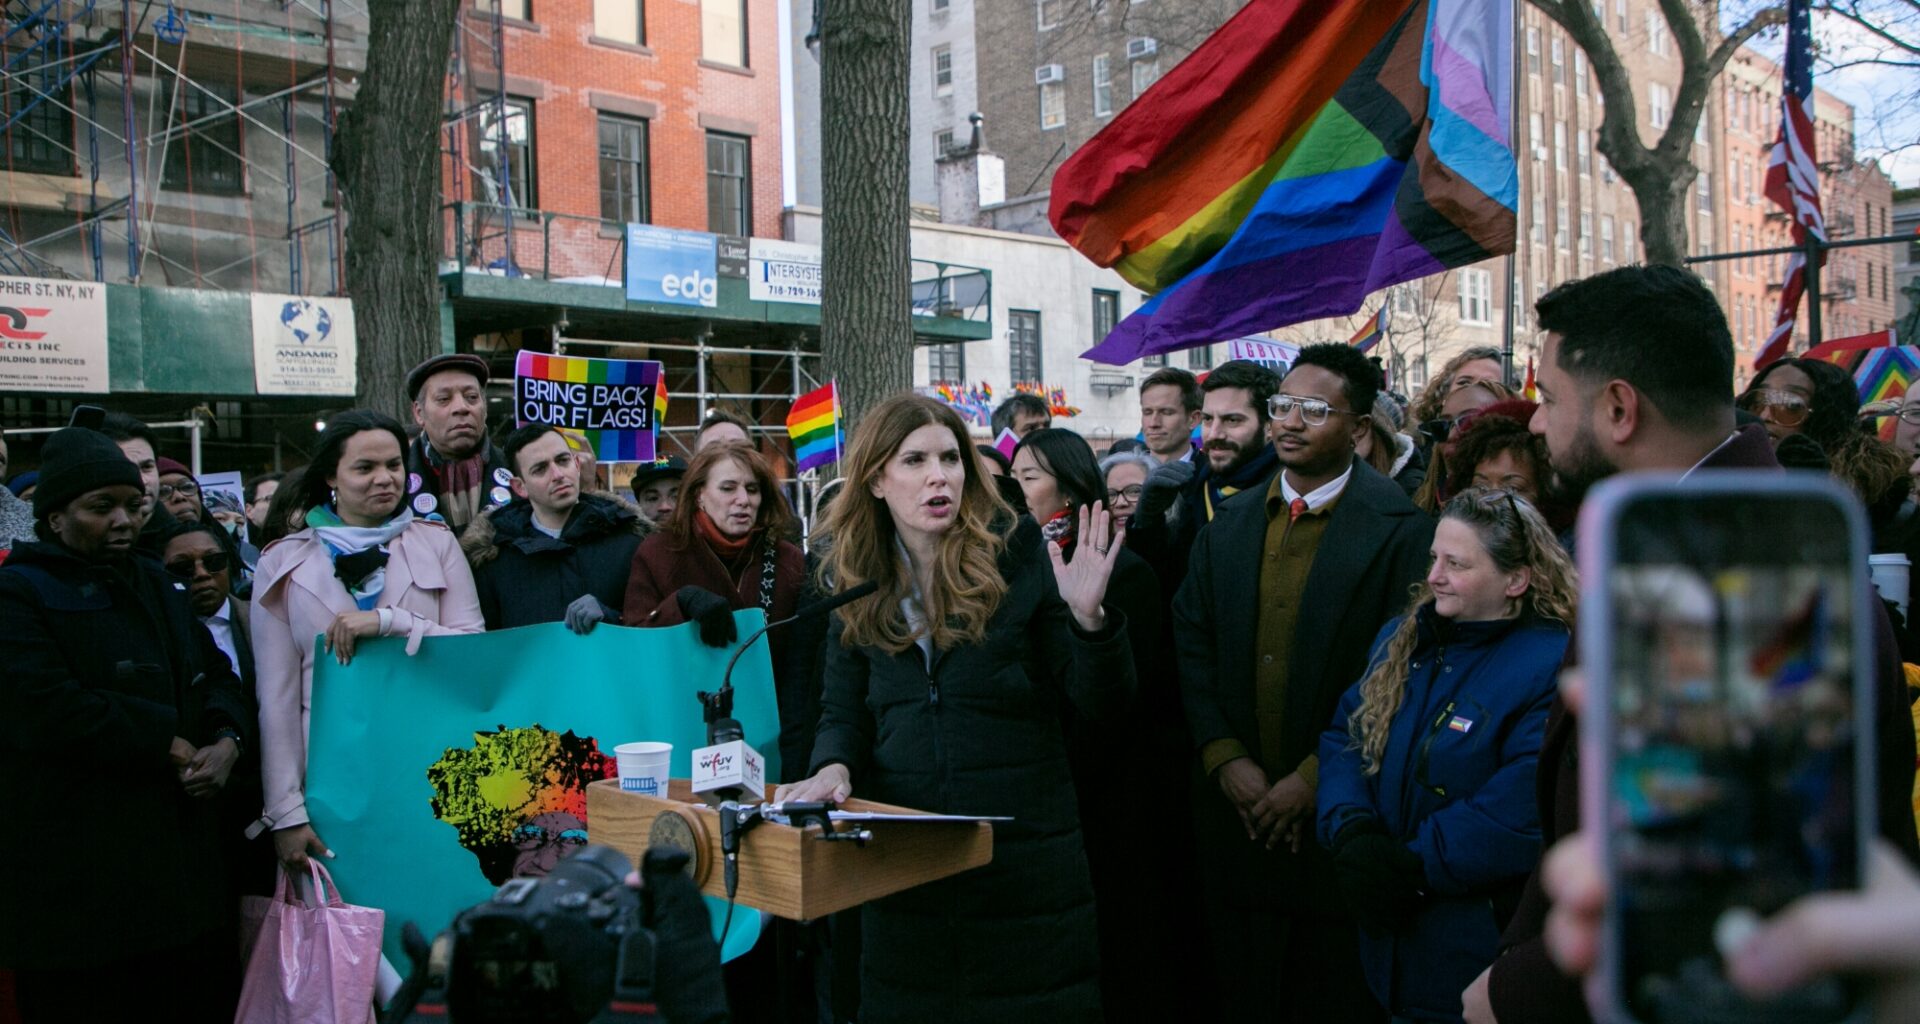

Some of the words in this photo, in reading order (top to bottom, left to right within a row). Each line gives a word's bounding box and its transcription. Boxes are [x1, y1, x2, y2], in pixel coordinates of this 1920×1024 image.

[35, 284, 53, 297] ST.
[56, 285, 75, 301] NY,
[79, 286, 95, 299] NY
[661, 270, 717, 308] edg
[38, 343, 61, 352] INC
[276, 350, 338, 358] ANDAMIO
[1234, 341, 1289, 360] LGBTQ
[39, 357, 86, 366] SERVICES
[524, 378, 587, 405] BRING
[592, 386, 649, 407] BACK
[523, 401, 567, 427] OUR
[571, 407, 647, 429] FLAGS!
